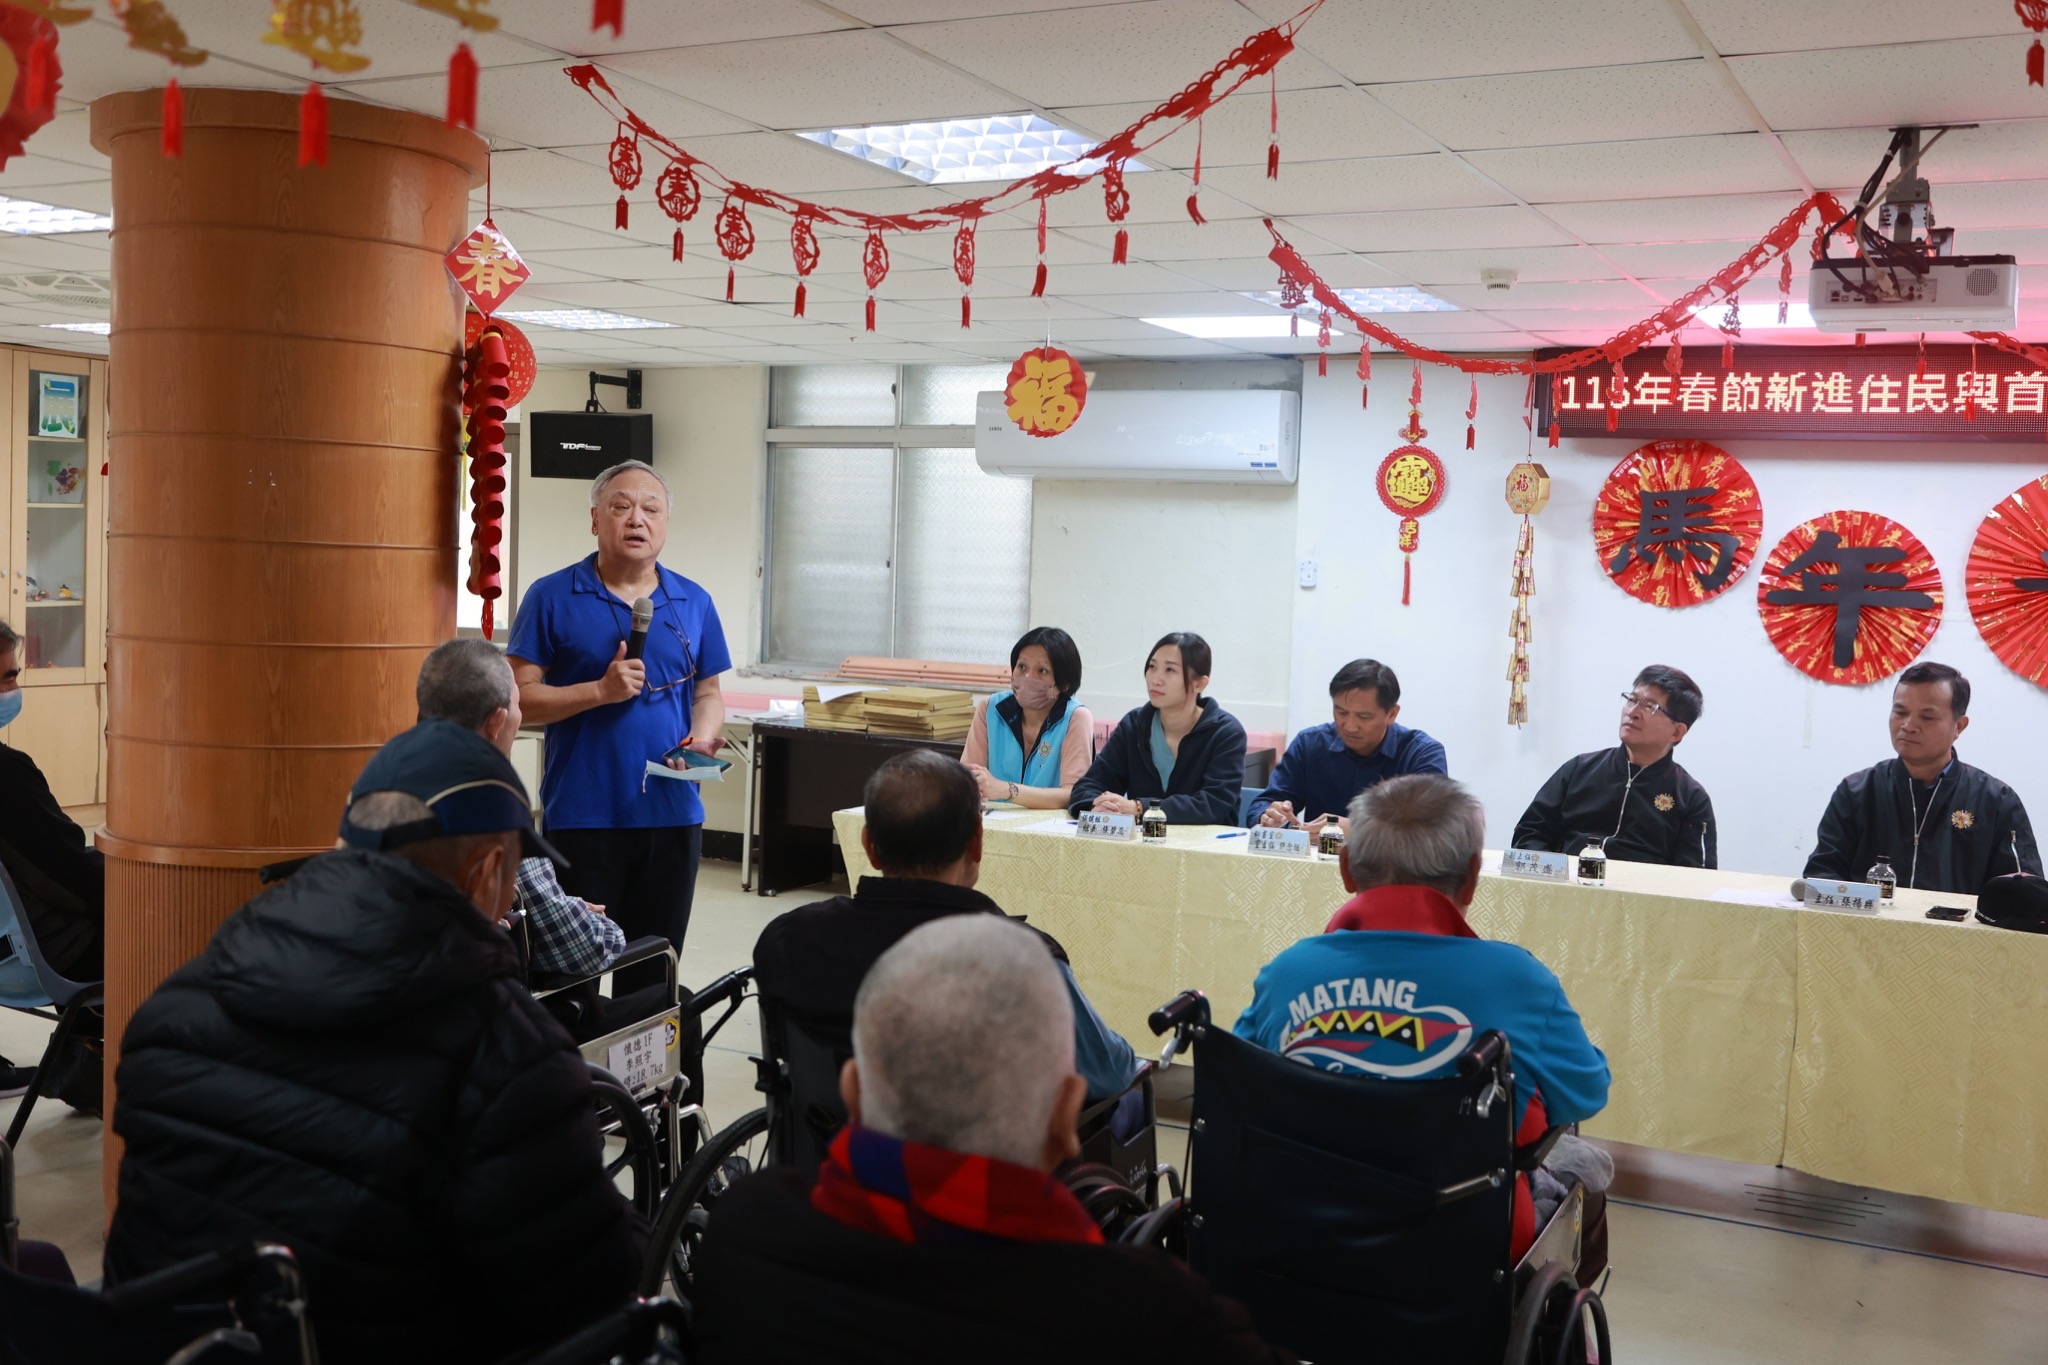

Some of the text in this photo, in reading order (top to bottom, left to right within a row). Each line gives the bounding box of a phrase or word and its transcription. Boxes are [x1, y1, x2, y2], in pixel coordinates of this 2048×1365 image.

[456, 234, 523, 299] 春
[1006, 356, 1079, 431] 福
[1611, 486, 1740, 591] 馬
[1766, 530, 1934, 669] 年
[1814, 893, 1834, 905] 主任
[1288, 977, 1418, 1026] MATANG
[644, 1032, 653, 1047] 1F
